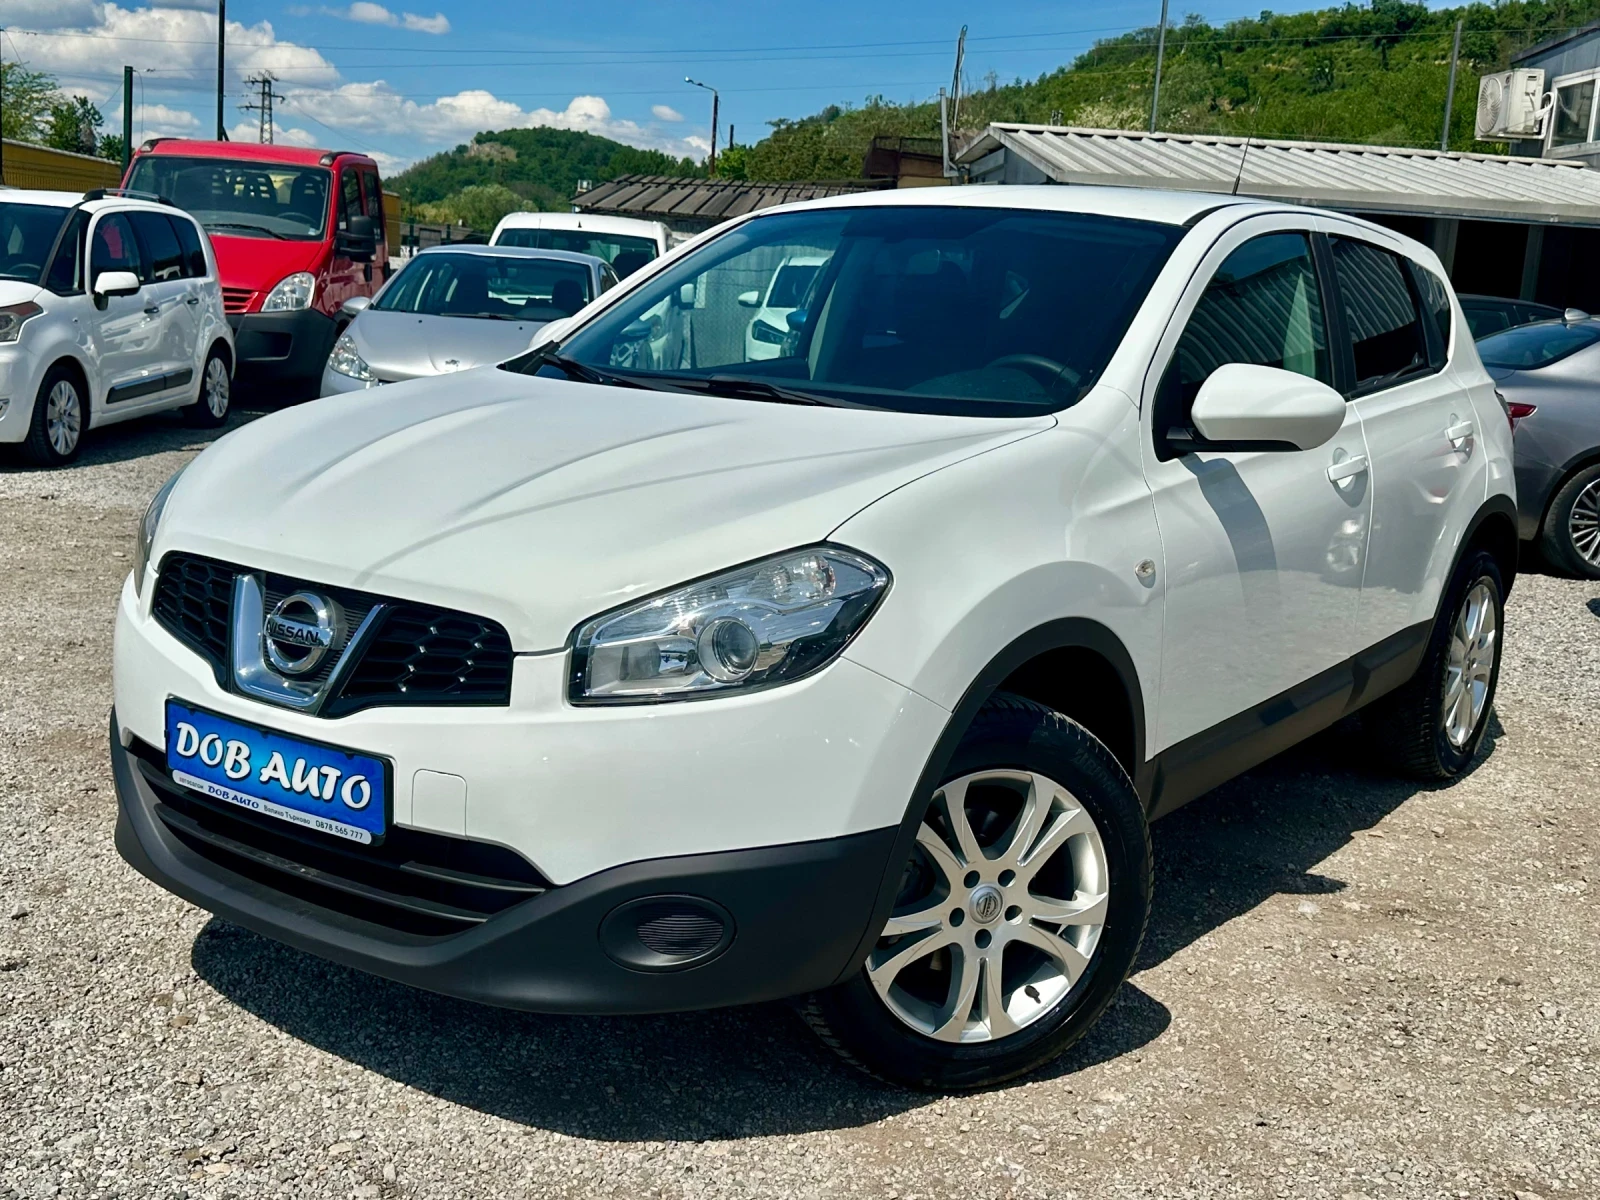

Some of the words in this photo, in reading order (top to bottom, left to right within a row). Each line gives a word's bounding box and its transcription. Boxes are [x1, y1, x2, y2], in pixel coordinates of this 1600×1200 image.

[266, 621, 319, 643] NISSAN
[175, 721, 251, 780] DOB
[259, 751, 372, 810] AUTO
[208, 785, 230, 799] DOB
[231, 794, 259, 809] AUTO
[315, 819, 333, 832] 0878
[334, 825, 348, 836] 565
[350, 829, 363, 840] 777
